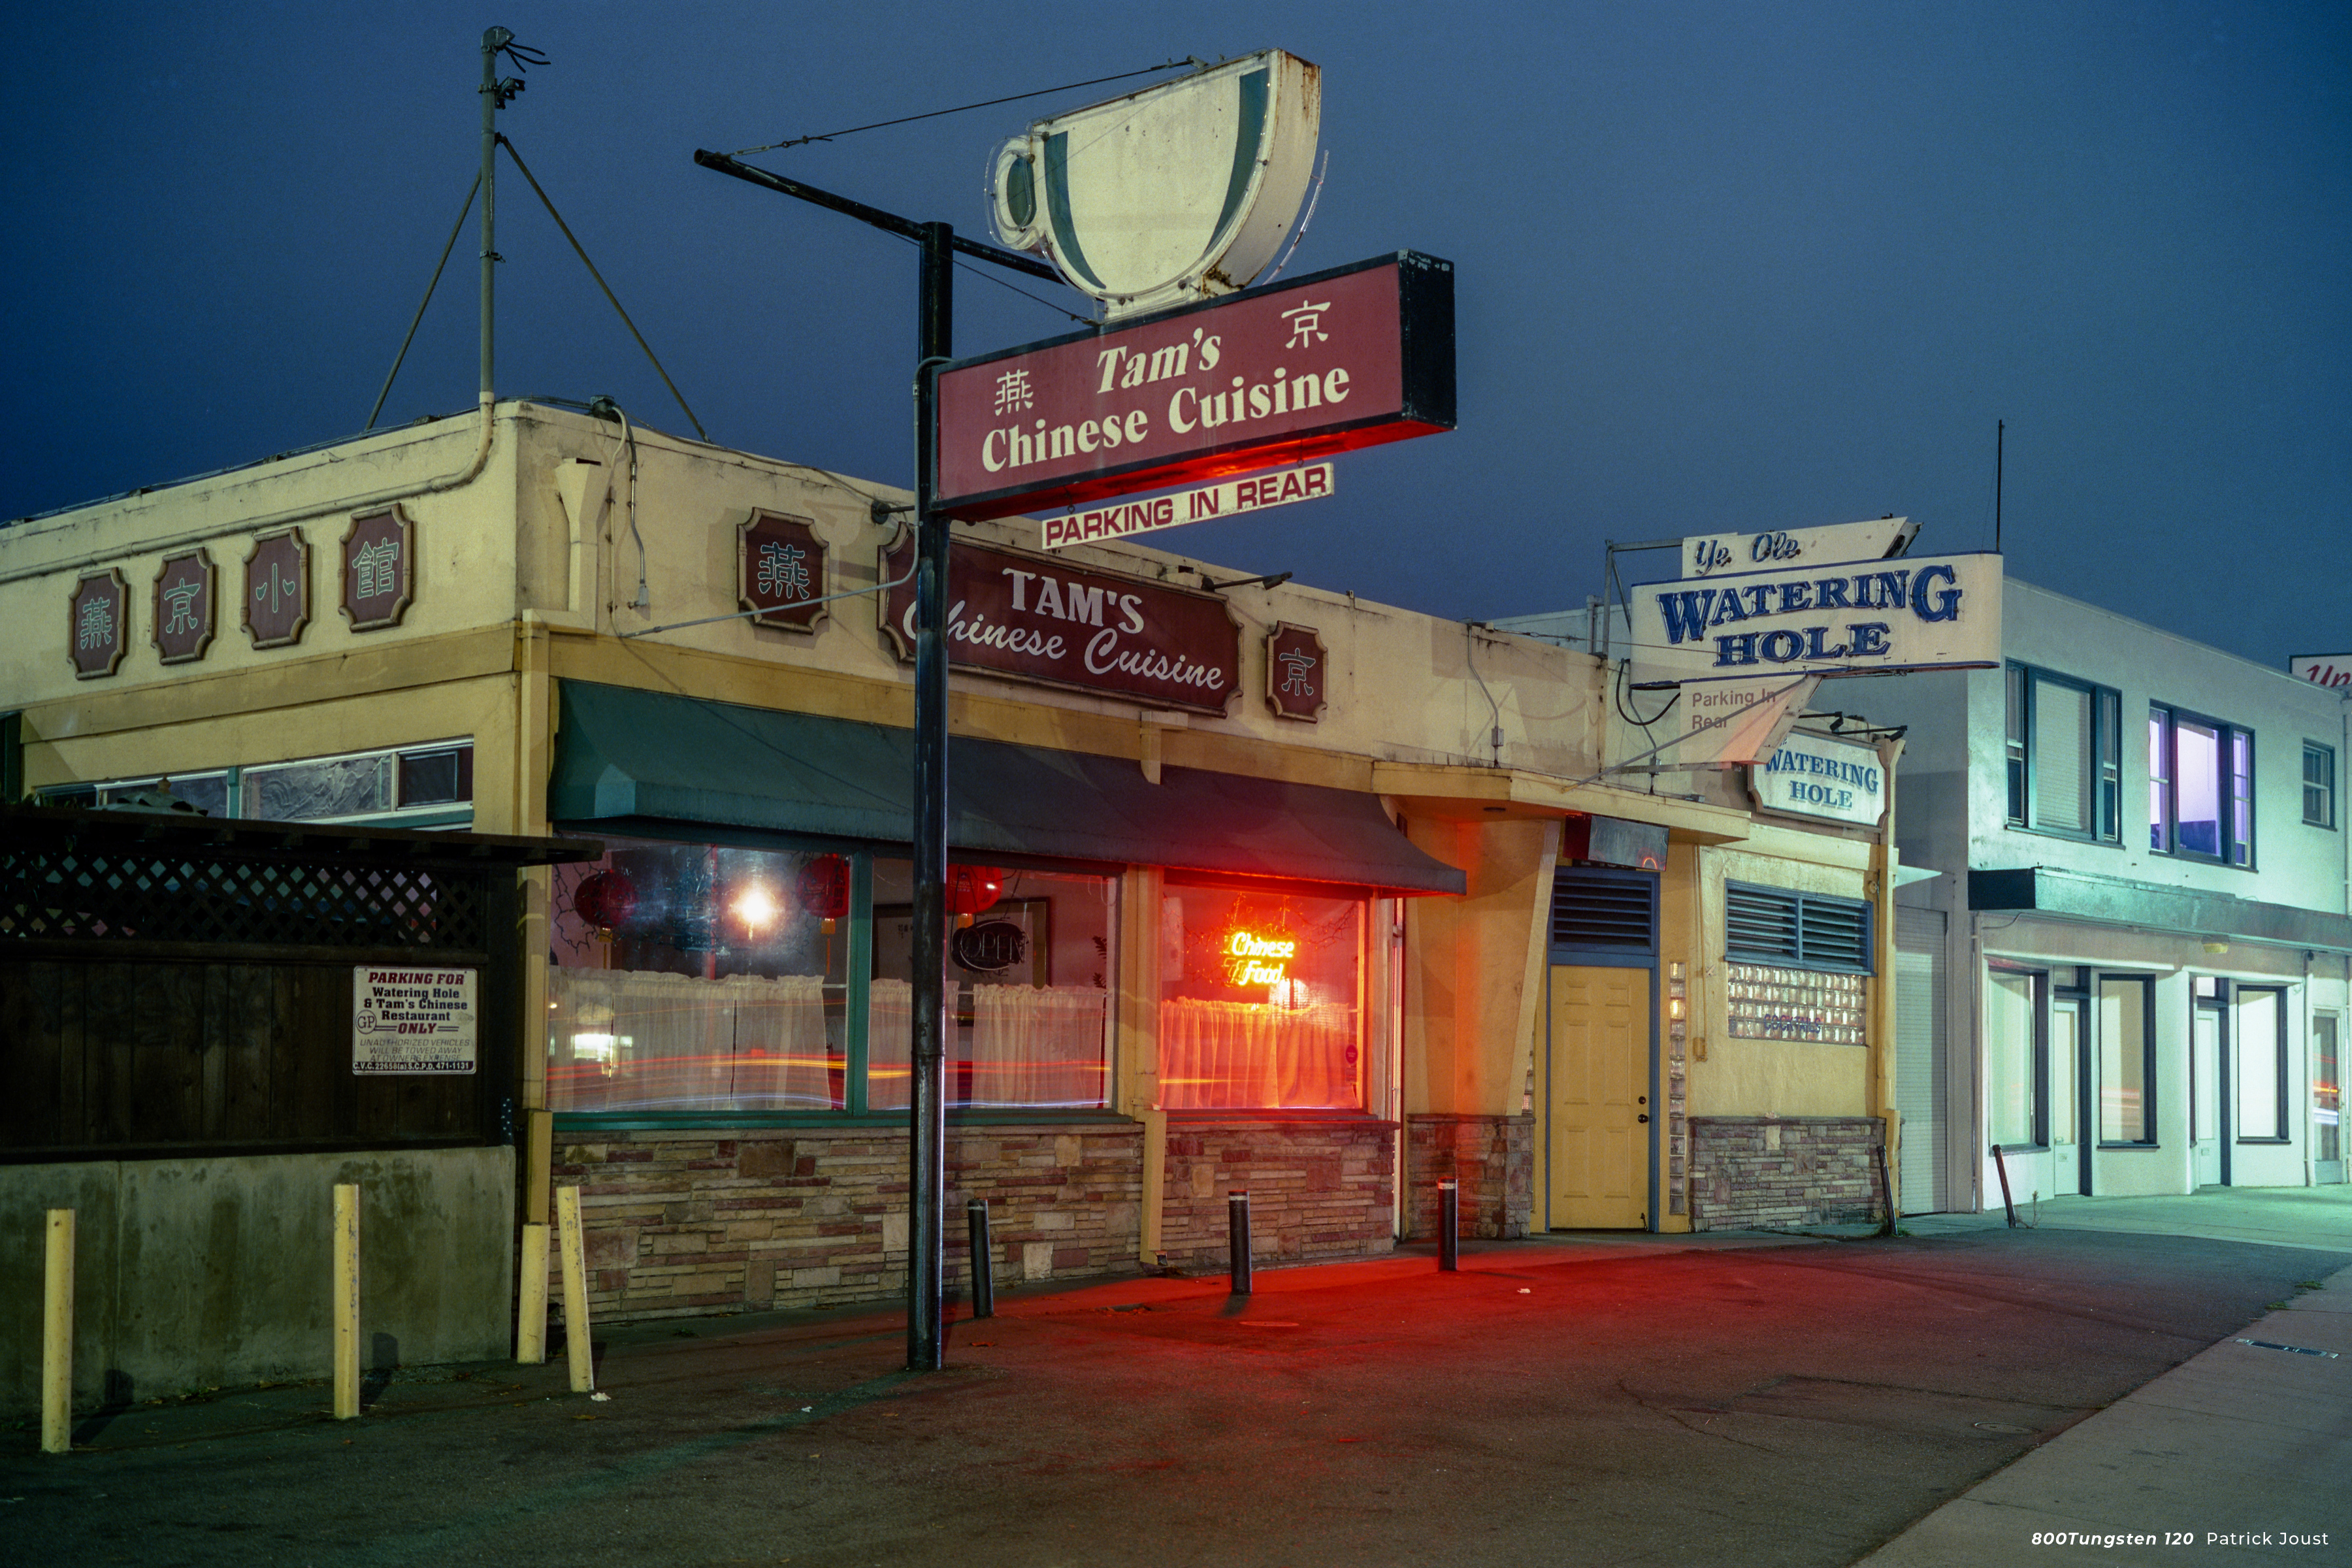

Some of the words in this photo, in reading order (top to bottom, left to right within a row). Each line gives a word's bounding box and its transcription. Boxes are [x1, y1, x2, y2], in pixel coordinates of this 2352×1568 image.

[1281, 300, 1331, 349] 京
[1096, 327, 1222, 393] Tam's
[995, 368, 1034, 416] 燕
[981, 410, 1148, 472] Chinese
[1169, 367, 1350, 434] Cuisine
[1047, 497, 1173, 546] PARKING
[1189, 488, 1219, 519] IN
[1237, 466, 1326, 510] REAR
[758, 541, 811, 599] 燕
[1695, 540, 1731, 576] Ye
[1751, 531, 1801, 563] Ole
[80, 597, 112, 649] 燕
[164, 578, 200, 634] 京
[255, 563, 295, 613] 小
[352, 537, 399, 599] 館
[1002, 567, 1145, 635] TAM'S
[1656, 564, 1963, 645] WATERING
[1085, 627, 1225, 690] Cuisine
[1712, 621, 1891, 668] HOLE
[1279, 647, 1316, 696] 京
[1692, 690, 1754, 707] Parking
[1762, 688, 1776, 703] In
[1692, 715, 1727, 730] Rear
[1765, 749, 1879, 794] WATERING
[1789, 779, 1853, 809] HOLE
[960, 928, 1026, 964] OPEN
[1232, 932, 1294, 957] Chinese
[368, 972, 433, 985] PARKING
[436, 973, 465, 985] FOR
[372, 987, 429, 1000] Watering
[433, 988, 460, 998] Hole
[1238, 960, 1284, 985] Food
[357, 1016, 375, 1028] GP
[364, 998, 372, 1009] &
[376, 998, 415, 1009] Tam's
[419, 999, 468, 1009] Chinese
[382, 1011, 450, 1021] Restaurant
[398, 1022, 437, 1034] ONLY
